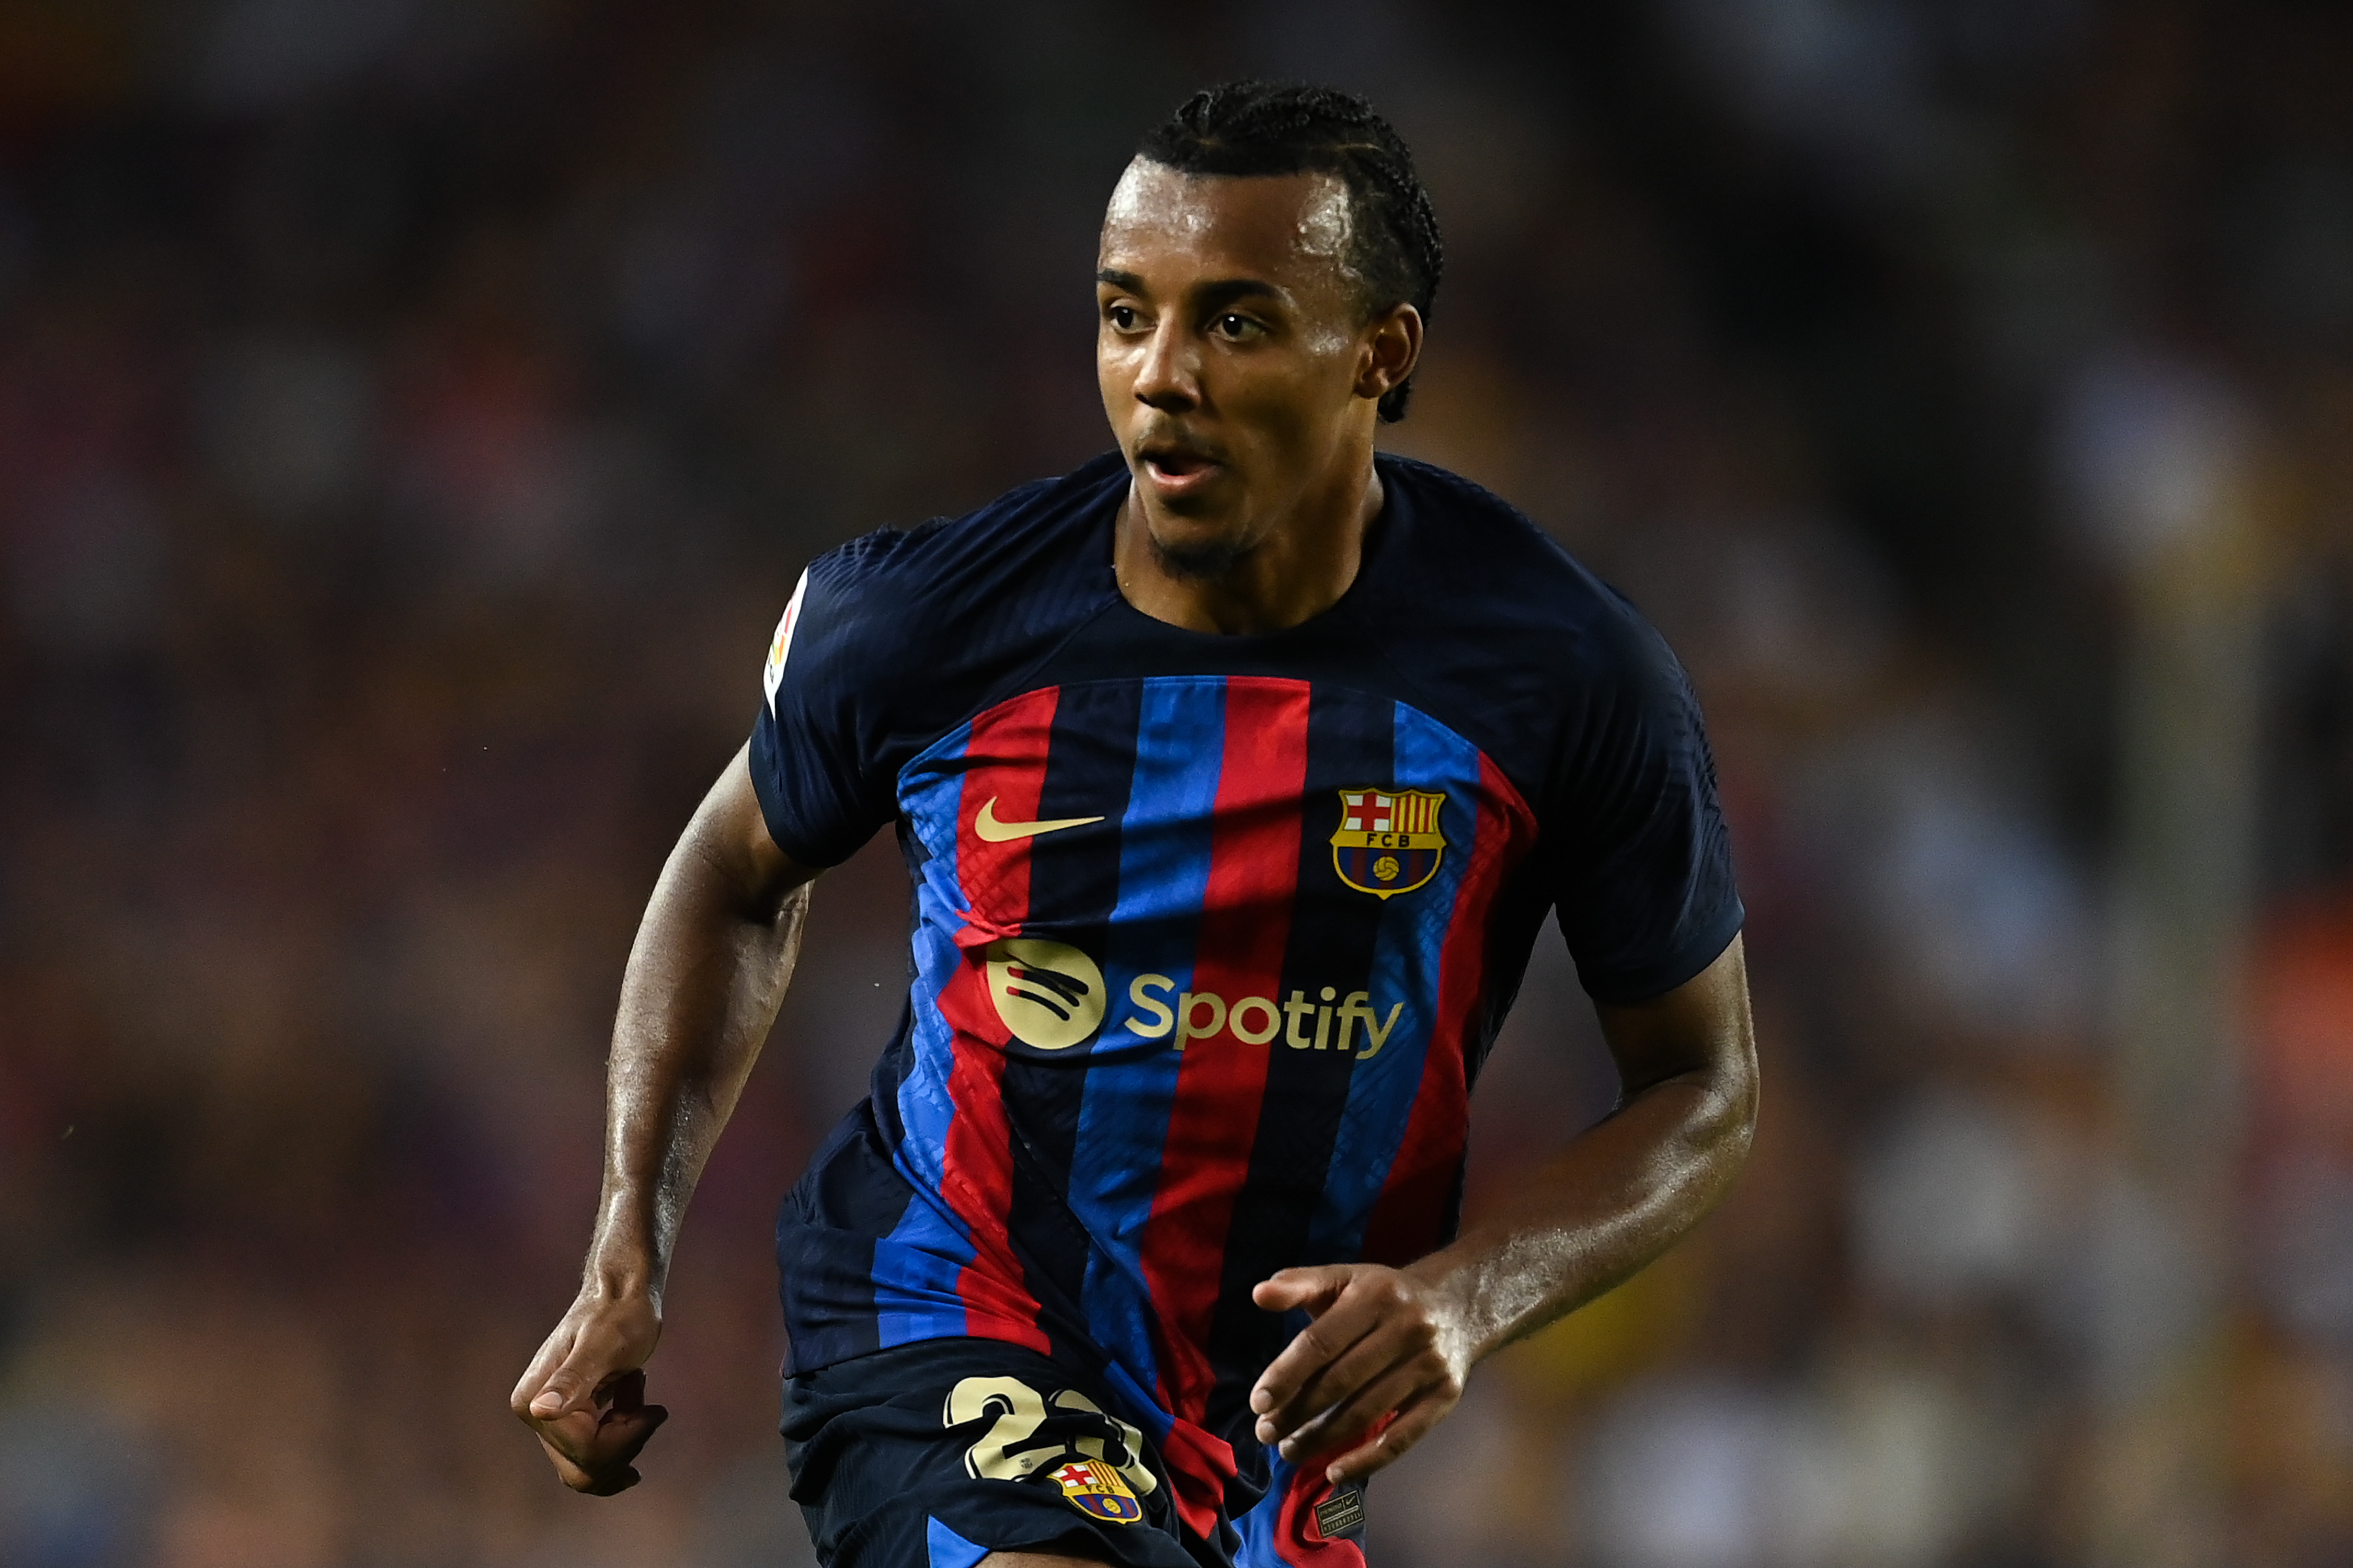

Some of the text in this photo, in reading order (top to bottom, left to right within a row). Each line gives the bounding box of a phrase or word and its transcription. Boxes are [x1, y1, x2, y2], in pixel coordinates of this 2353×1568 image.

[1366, 833, 1410, 848] FCB
[1124, 973, 1404, 1060] Spotify
[1086, 1485, 1115, 1494] FCB
